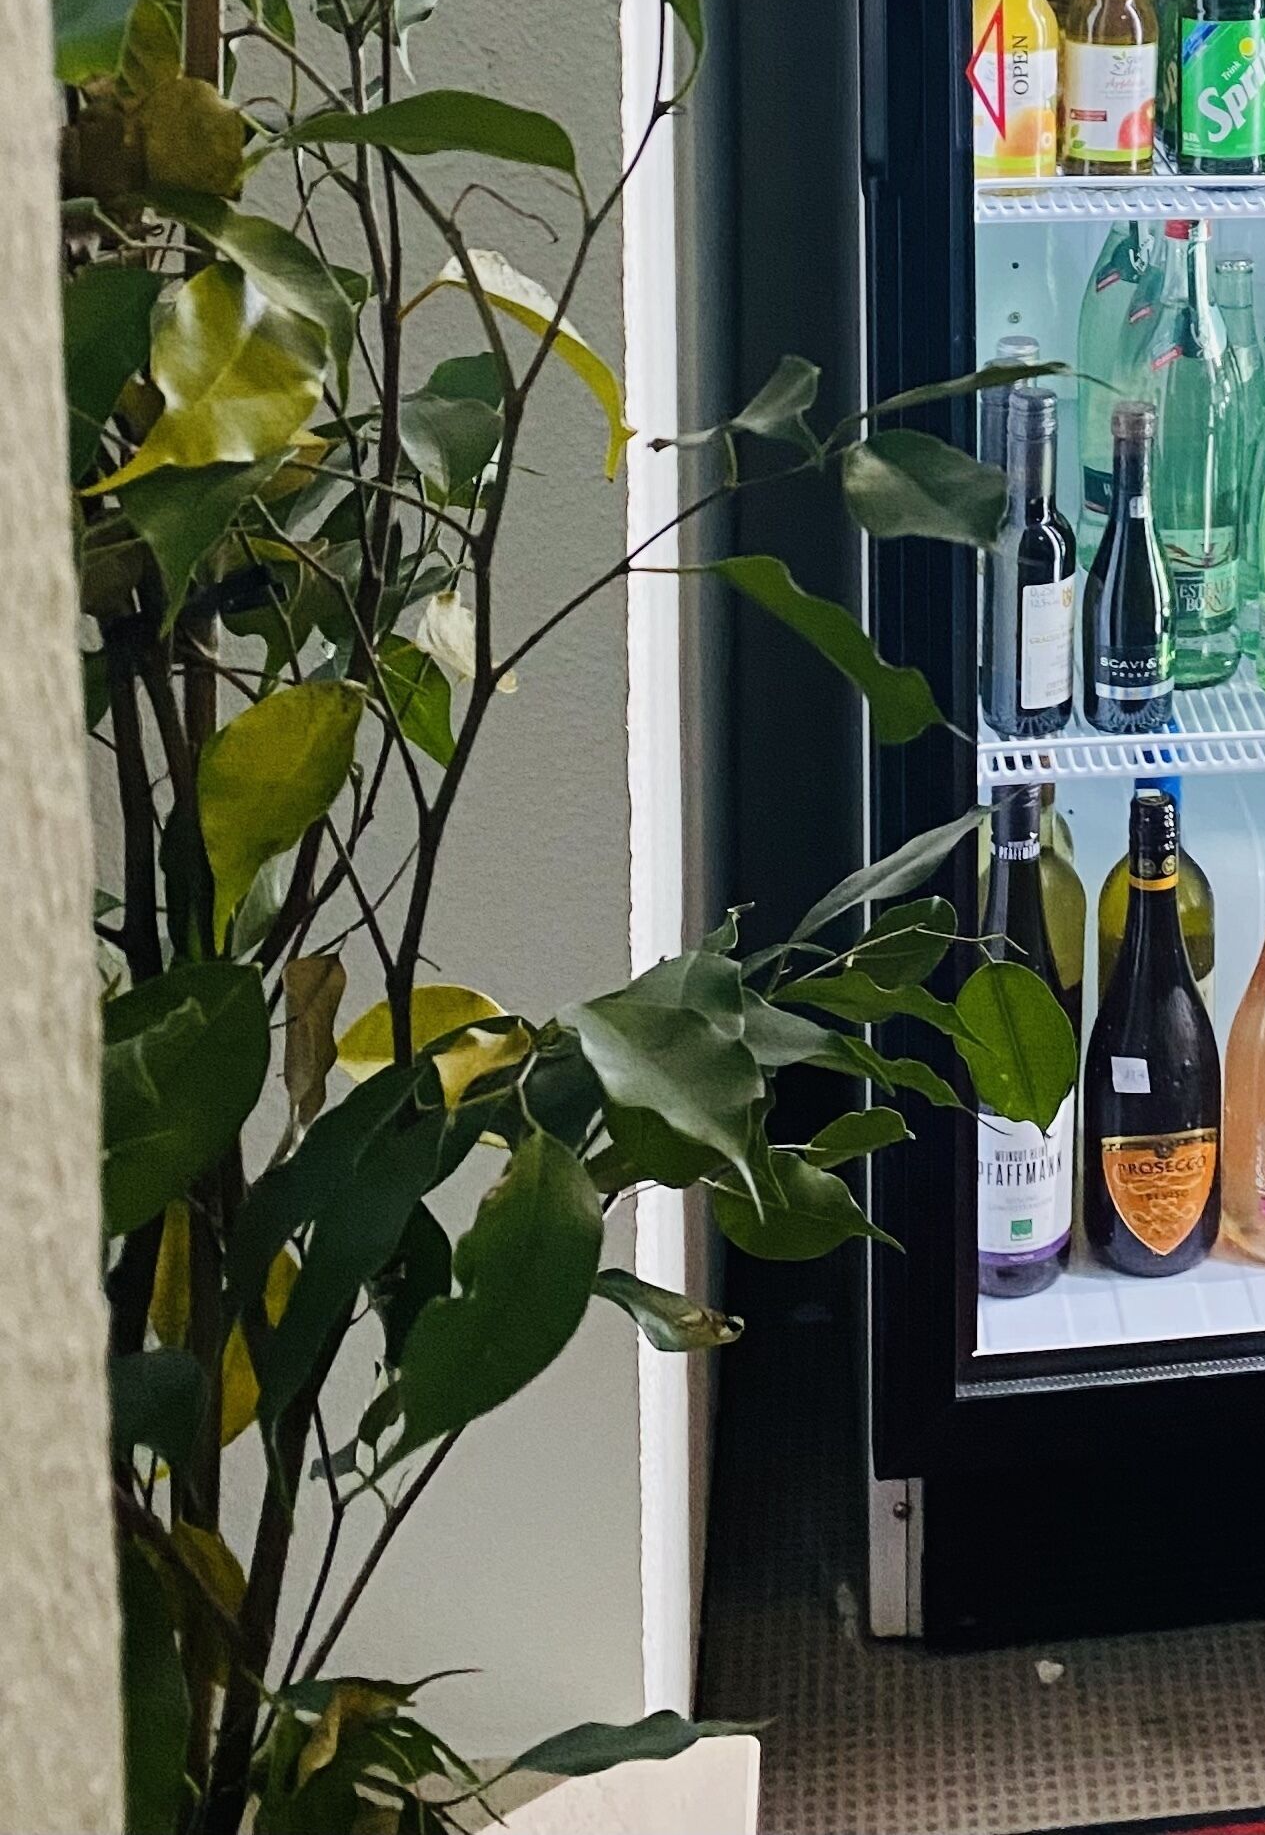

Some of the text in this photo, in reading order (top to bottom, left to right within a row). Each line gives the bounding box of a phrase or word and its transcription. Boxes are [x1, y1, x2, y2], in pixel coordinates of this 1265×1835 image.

[1012, 35, 1030, 95] OPEN
[1220, 60, 1243, 81] Trink
[978, 1149, 1062, 1186] PFAFFMANN
[1117, 1154, 1207, 1175] PROSECCO
